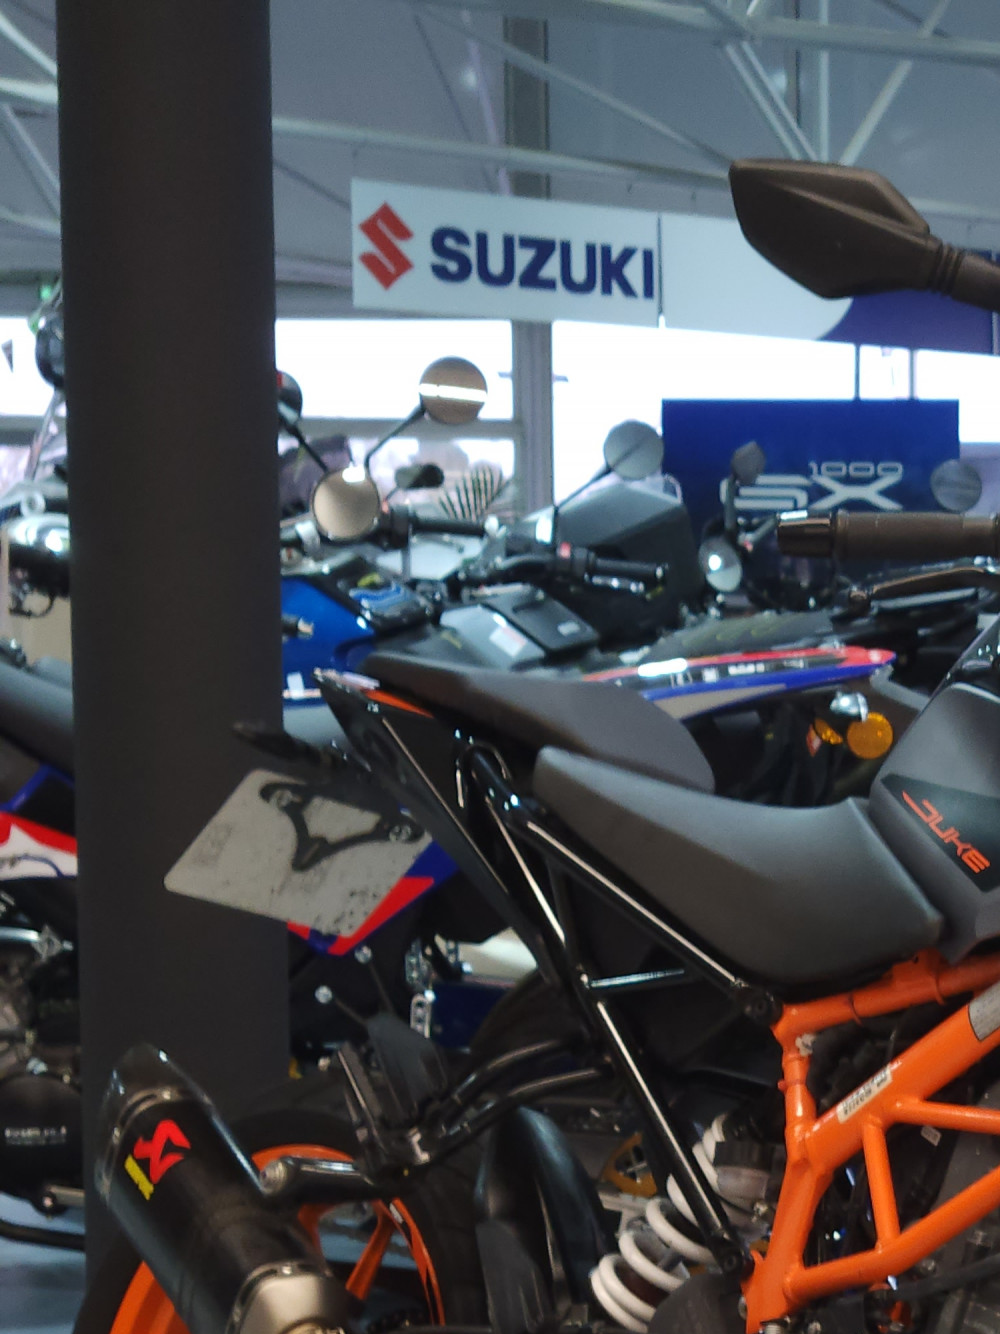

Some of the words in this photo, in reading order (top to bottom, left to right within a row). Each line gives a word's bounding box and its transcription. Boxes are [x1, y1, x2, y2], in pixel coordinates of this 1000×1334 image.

[430, 226, 655, 300] SUZUKI
[809, 461, 903, 477] 1000
[902, 790, 991, 873] DUKE
